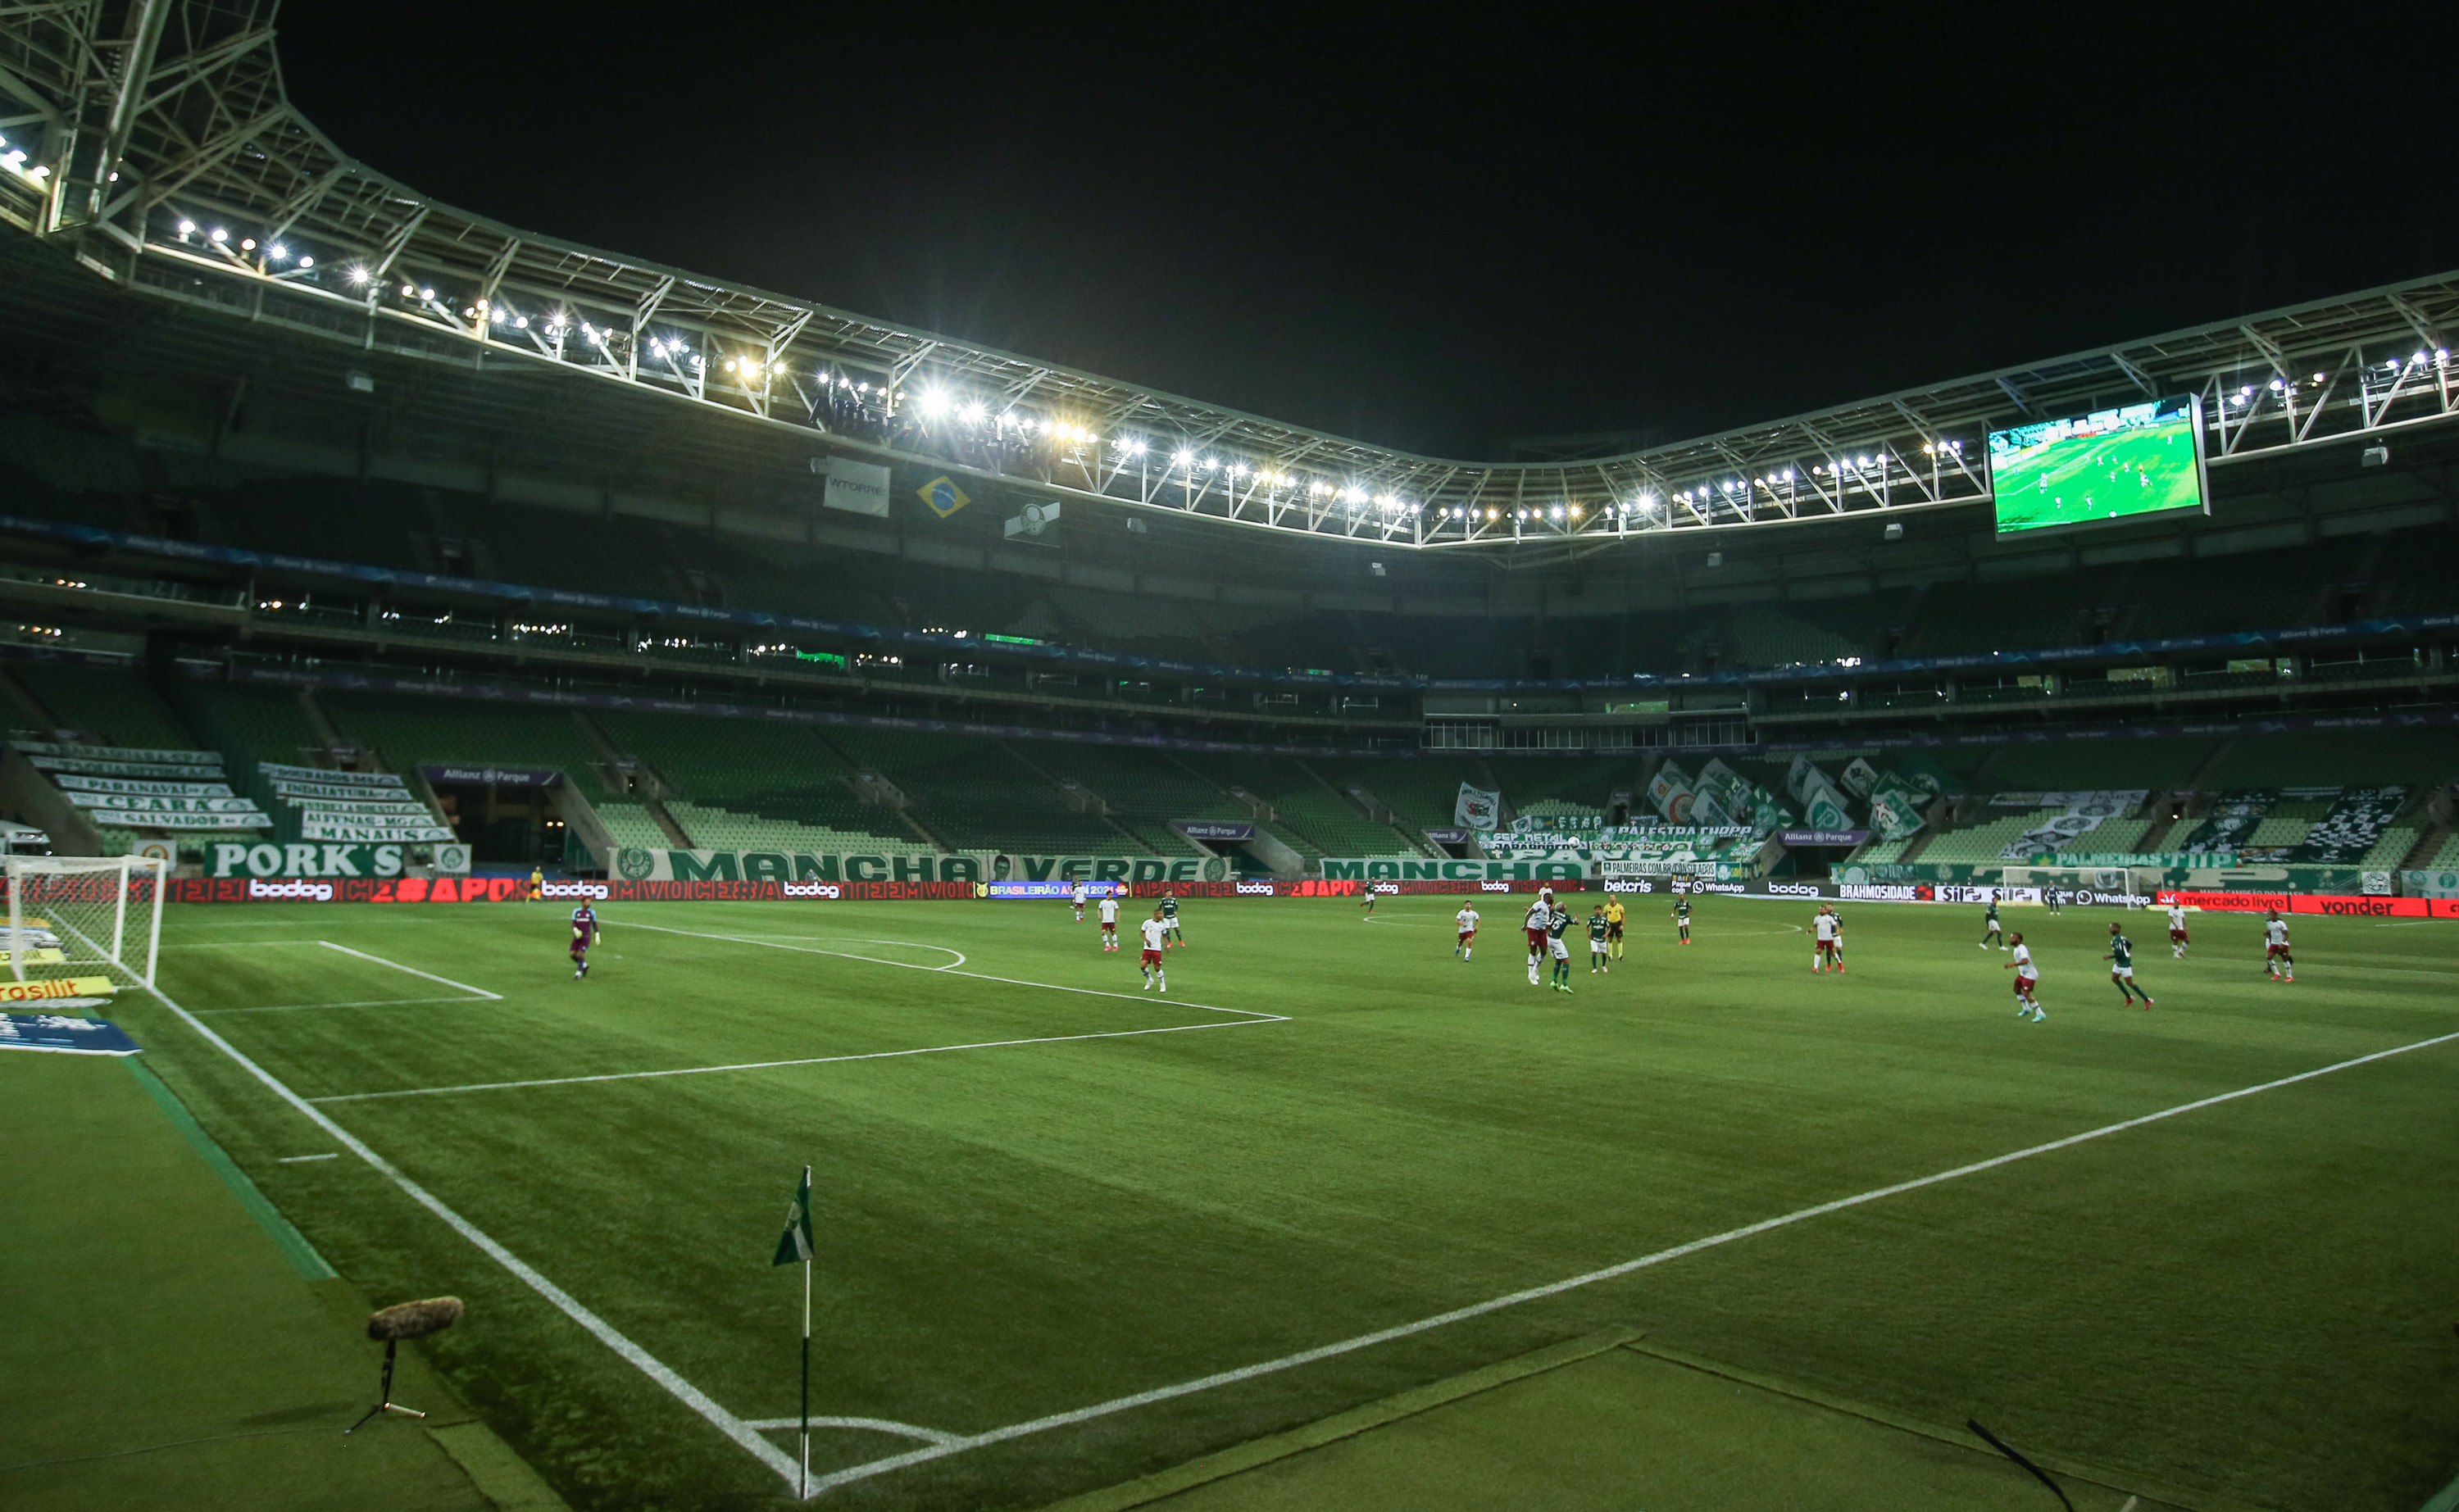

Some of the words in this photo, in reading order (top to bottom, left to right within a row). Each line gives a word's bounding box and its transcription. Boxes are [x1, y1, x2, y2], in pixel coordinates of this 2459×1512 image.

[829, 477, 883, 495] WTORRE
[444, 769, 481, 780] Allianz
[497, 770, 530, 784] Parque
[124, 813, 220, 826] SALVADOR
[320, 827, 419, 840] MANAUS
[1187, 826, 1208, 835] Allianz
[1216, 827, 1236, 837] Parque
[1493, 833, 1519, 841] SEP
[1525, 833, 1566, 842] METAL
[1618, 826, 1695, 836] PALESTRA
[1700, 825, 1752, 836] CHOPP
[1784, 833, 1812, 842] Allianz
[1825, 833, 1852, 842] Parque
[213, 842, 403, 878] PORK'S
[666, 849, 981, 883] MANCHA
[1021, 856, 1200, 883] VERDE
[2056, 852, 2164, 867] PALMEIRAS
[1322, 860, 1583, 881] MANCHA
[1612, 862, 1715, 875] PALMEIRAS.COM.BR/CONSULADOS
[249, 878, 334, 901] bodog
[541, 879, 609, 900] bodog
[784, 881, 840, 899] bodog
[989, 883, 1060, 896] BRASILEIRÃO
[1089, 884, 1115, 895] 2021
[1236, 881, 1275, 897] bodog
[1366, 880, 1400, 895] odog
[1480, 880, 1510, 893] bodog
[1603, 879, 1652, 893] betcris
[1671, 880, 1692, 888] Pague
[1705, 883, 1745, 894] WhatsApp
[1767, 882, 1820, 898] bodog
[1839, 884, 1916, 900] BRAHMOSIDADE
[1943, 887, 1964, 902] Sil
[2093, 892, 2151, 906] WhatsApp
[2184, 895, 2250, 908] mercado
[2252, 896, 2284, 909] livre
[2320, 897, 2394, 915] yonder
